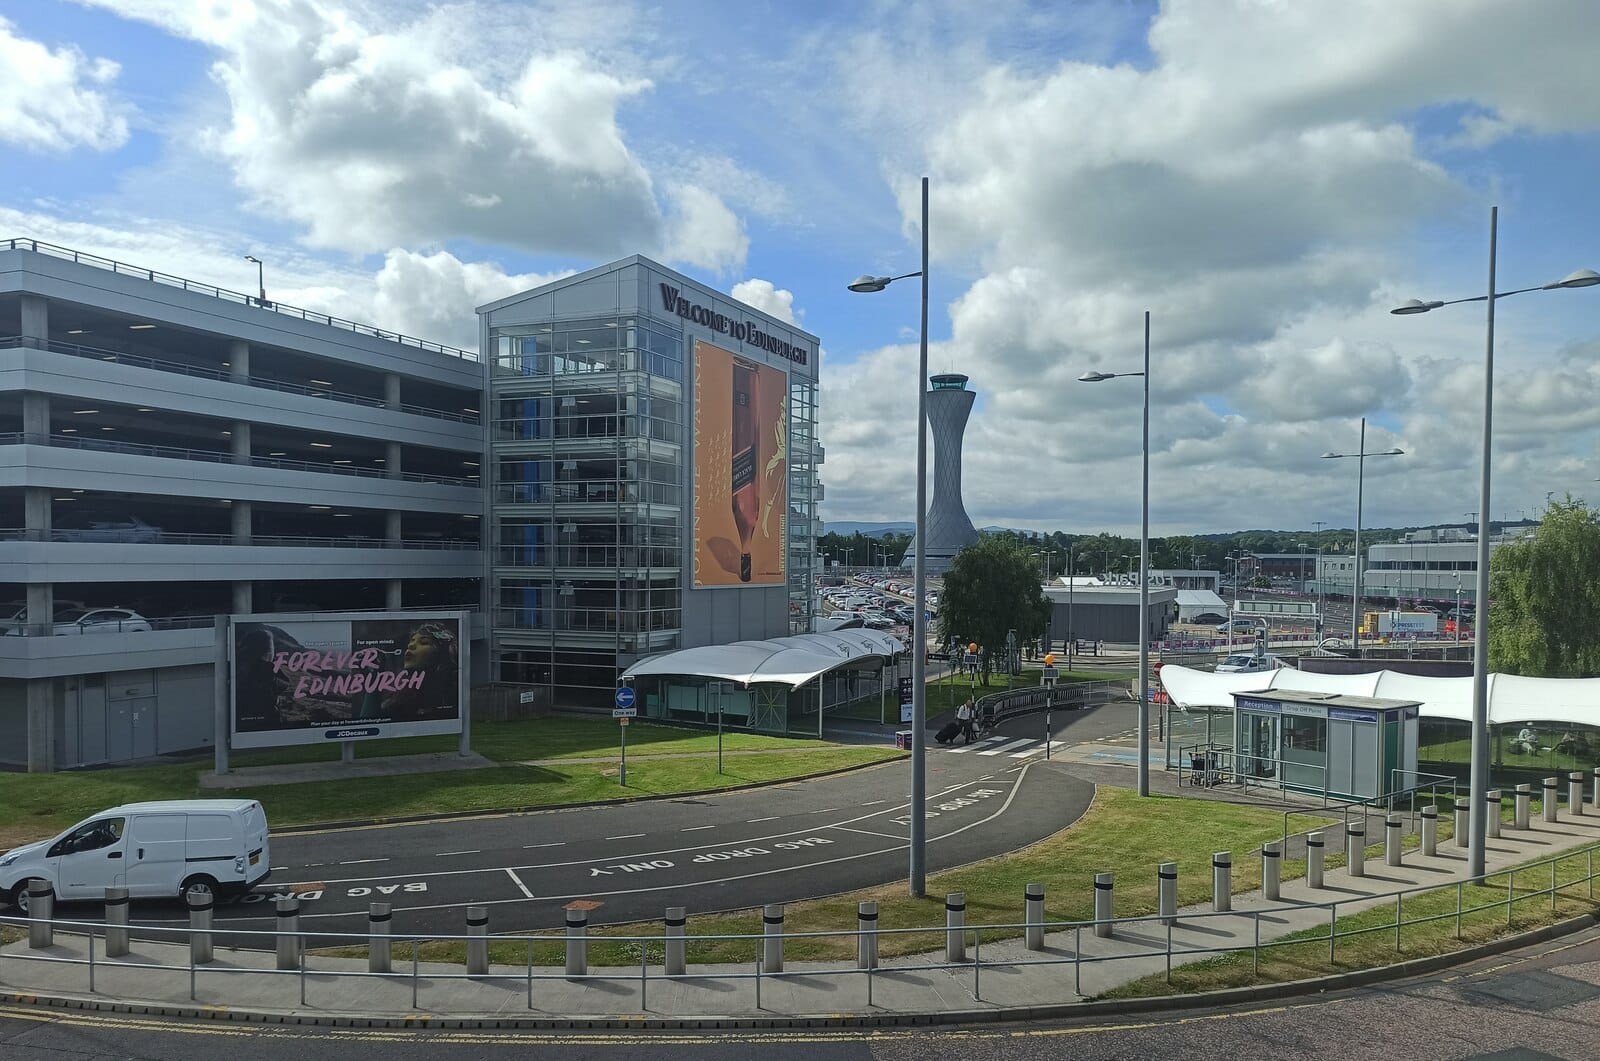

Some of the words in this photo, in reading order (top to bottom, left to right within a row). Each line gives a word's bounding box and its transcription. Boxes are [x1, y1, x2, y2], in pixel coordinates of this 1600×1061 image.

[660, 283, 728, 334] WELCOME
[728, 319, 746, 340] TO
[746, 321, 808, 365] EDINBURGH
[272, 647, 380, 673] FOREVER
[294, 670, 426, 699] EDINBURGH
[1243, 701, 1273, 709] Reception
[336, 730, 369, 738] JCDecaux
[774, 837, 835, 850] BAG
[692, 847, 773, 863] DROP
[590, 860, 675, 877] ONLY
[347, 882, 428, 897] BAG
